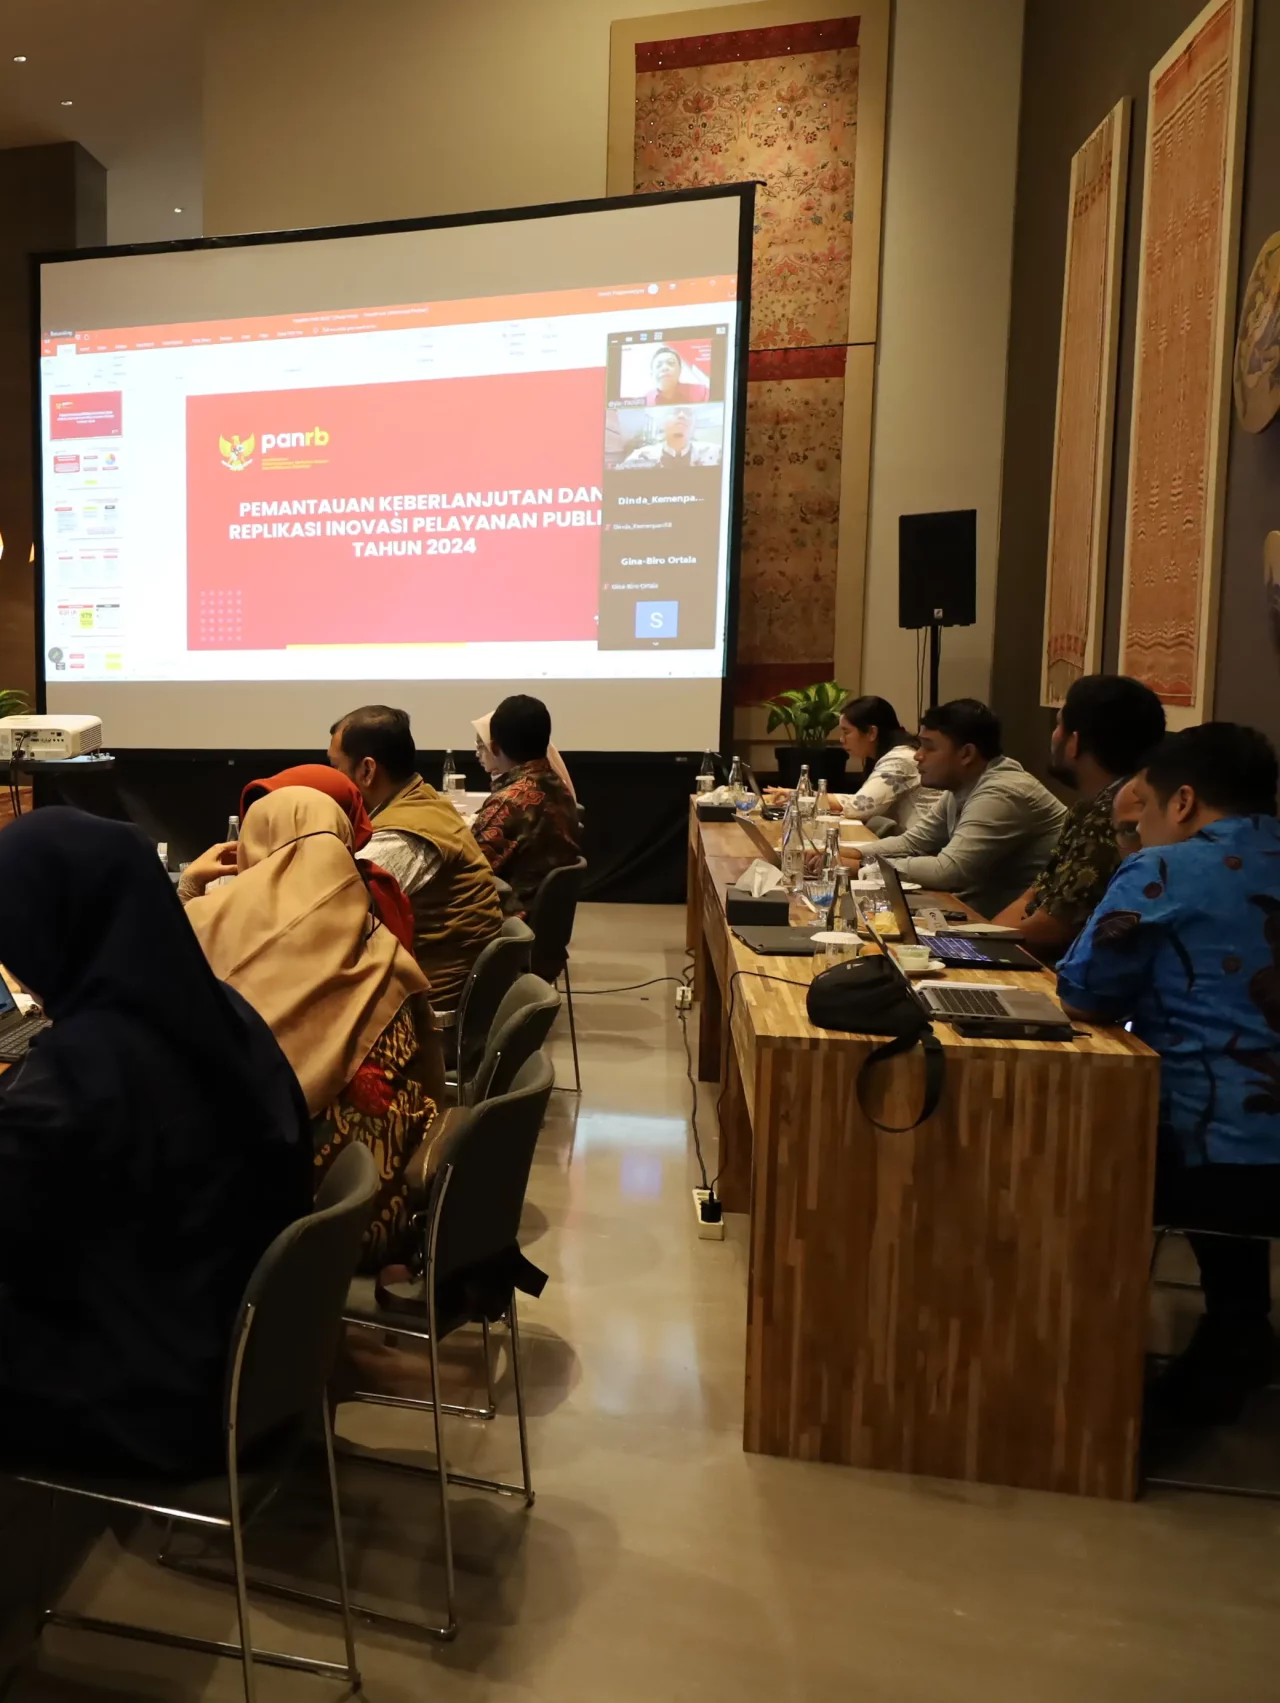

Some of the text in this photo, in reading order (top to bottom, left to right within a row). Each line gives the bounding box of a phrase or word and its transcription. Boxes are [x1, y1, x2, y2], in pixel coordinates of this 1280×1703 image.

[261, 426, 329, 454] panrb
[239, 486, 603, 517] PEMANTAUAN KEBERLANJUTAN DAN
[229, 509, 602, 540] REPLIKASI INOVASI PELAYANAN PUBLI
[351, 537, 477, 558] TAHUN 2024
[649, 612, 664, 629] S
